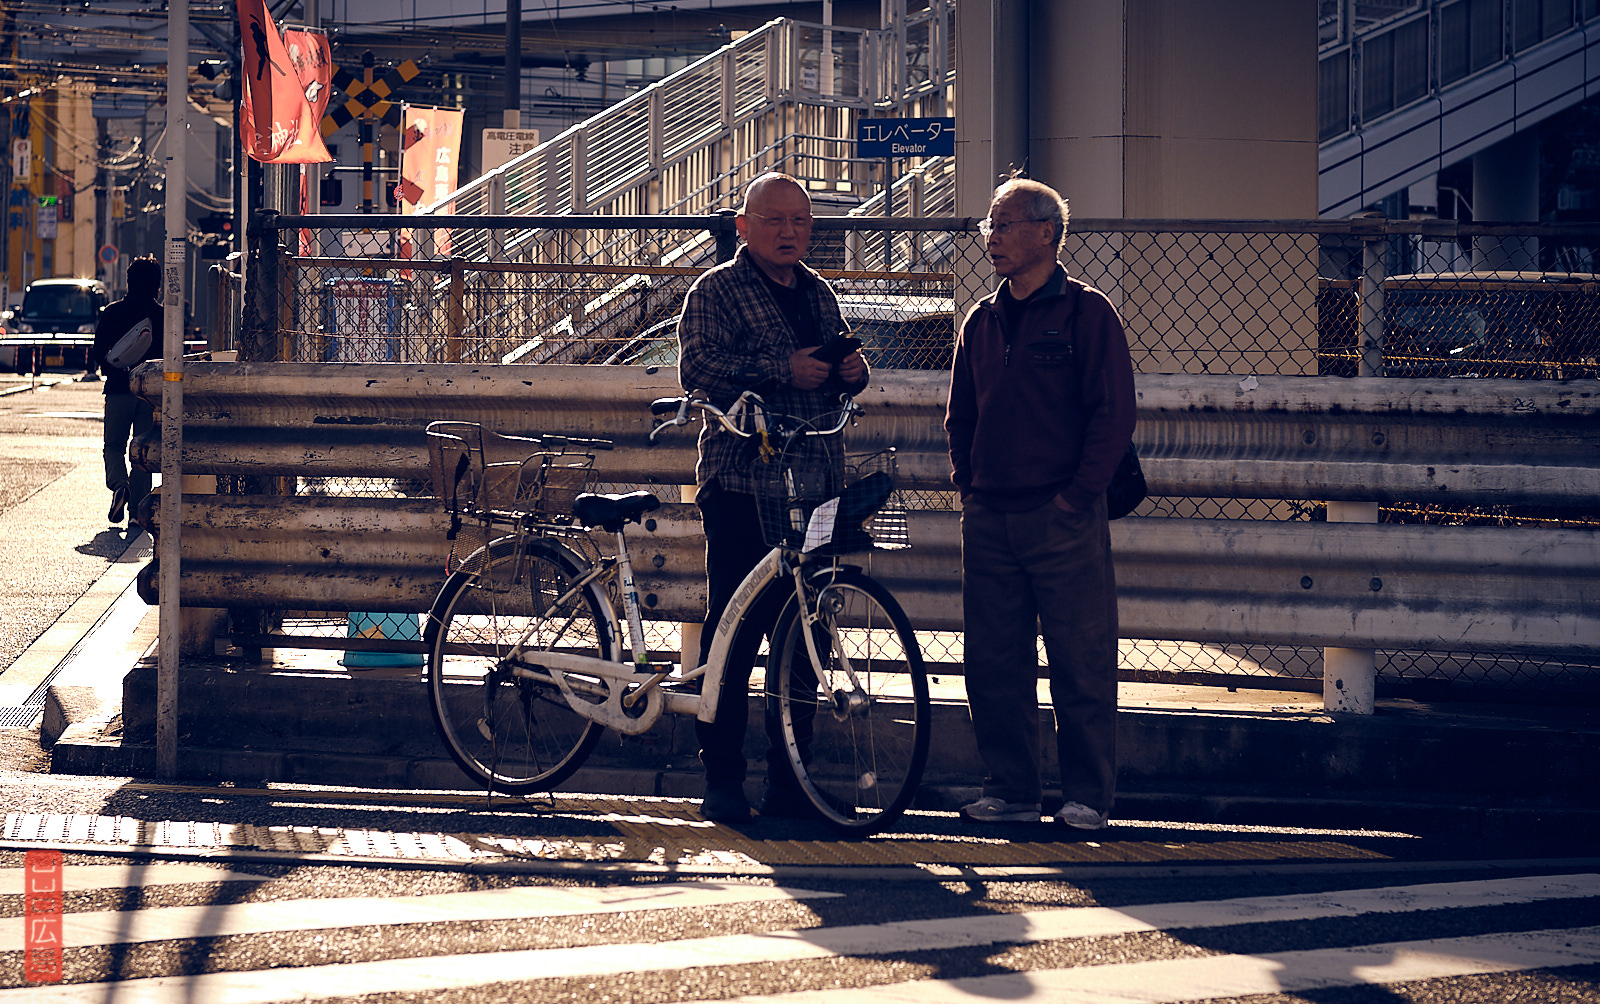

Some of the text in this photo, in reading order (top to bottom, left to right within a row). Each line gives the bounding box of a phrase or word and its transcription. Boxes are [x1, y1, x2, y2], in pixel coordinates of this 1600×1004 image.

[862, 122, 955, 142] エレベーター
[891, 143, 926, 154] Elevator
